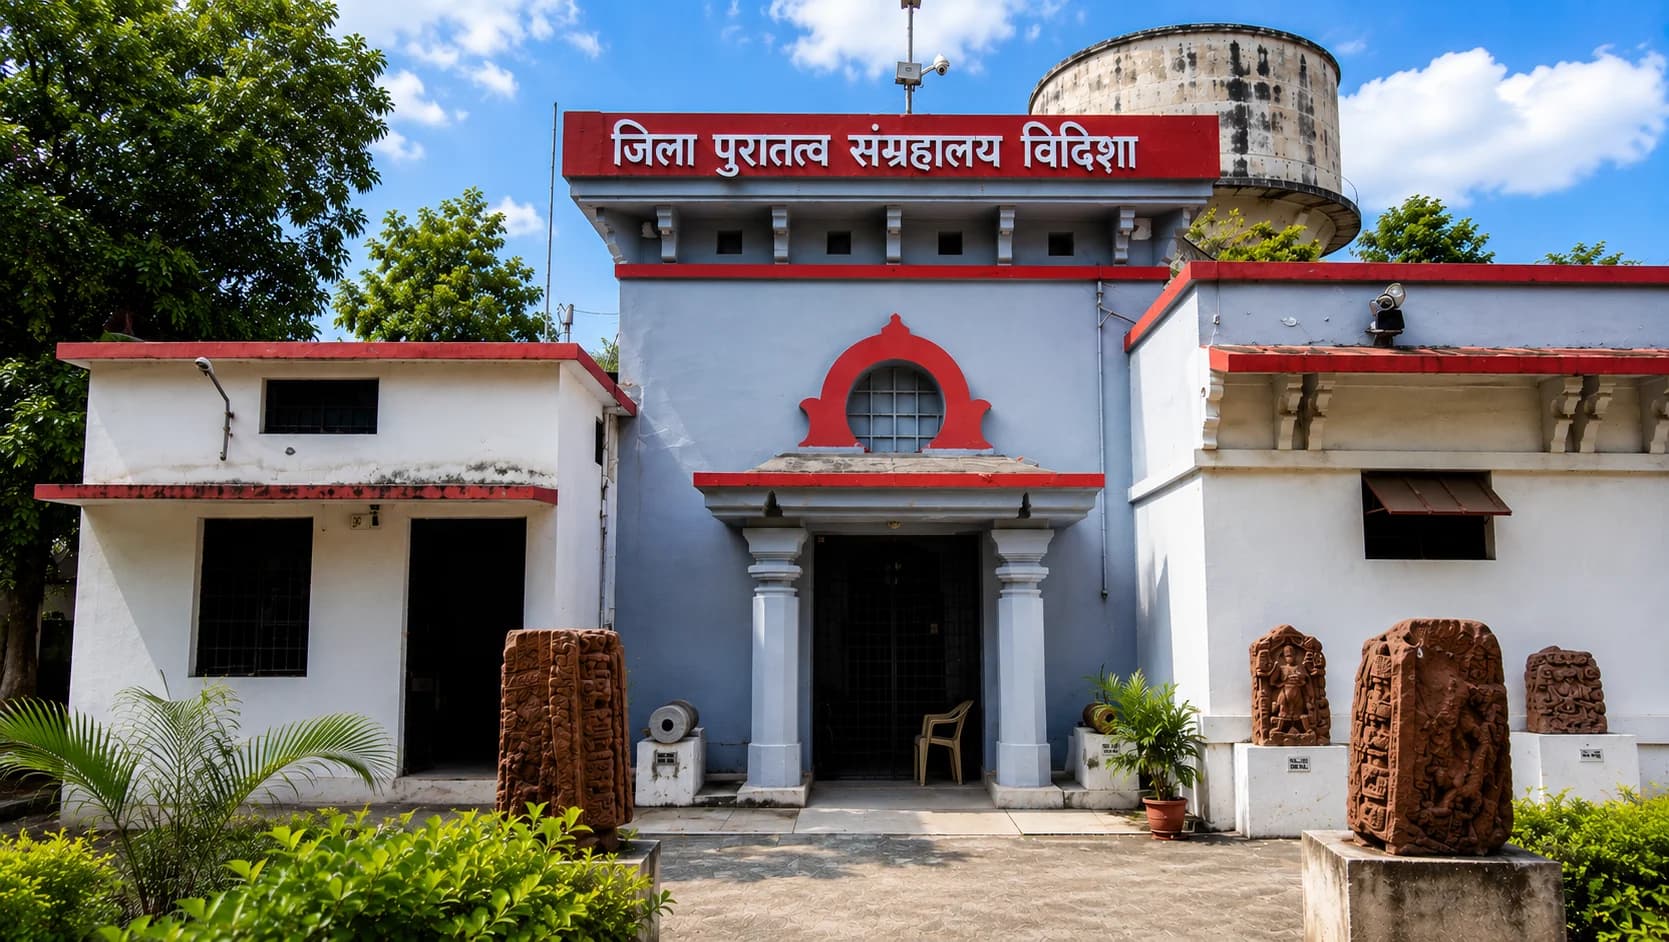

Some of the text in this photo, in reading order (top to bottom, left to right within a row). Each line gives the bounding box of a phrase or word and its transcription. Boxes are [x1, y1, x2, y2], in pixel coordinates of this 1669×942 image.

[611, 118, 698, 167] जिला
[712, 134, 831, 178] पुरातत्व
[1020, 121, 1139, 174] विदिशा
